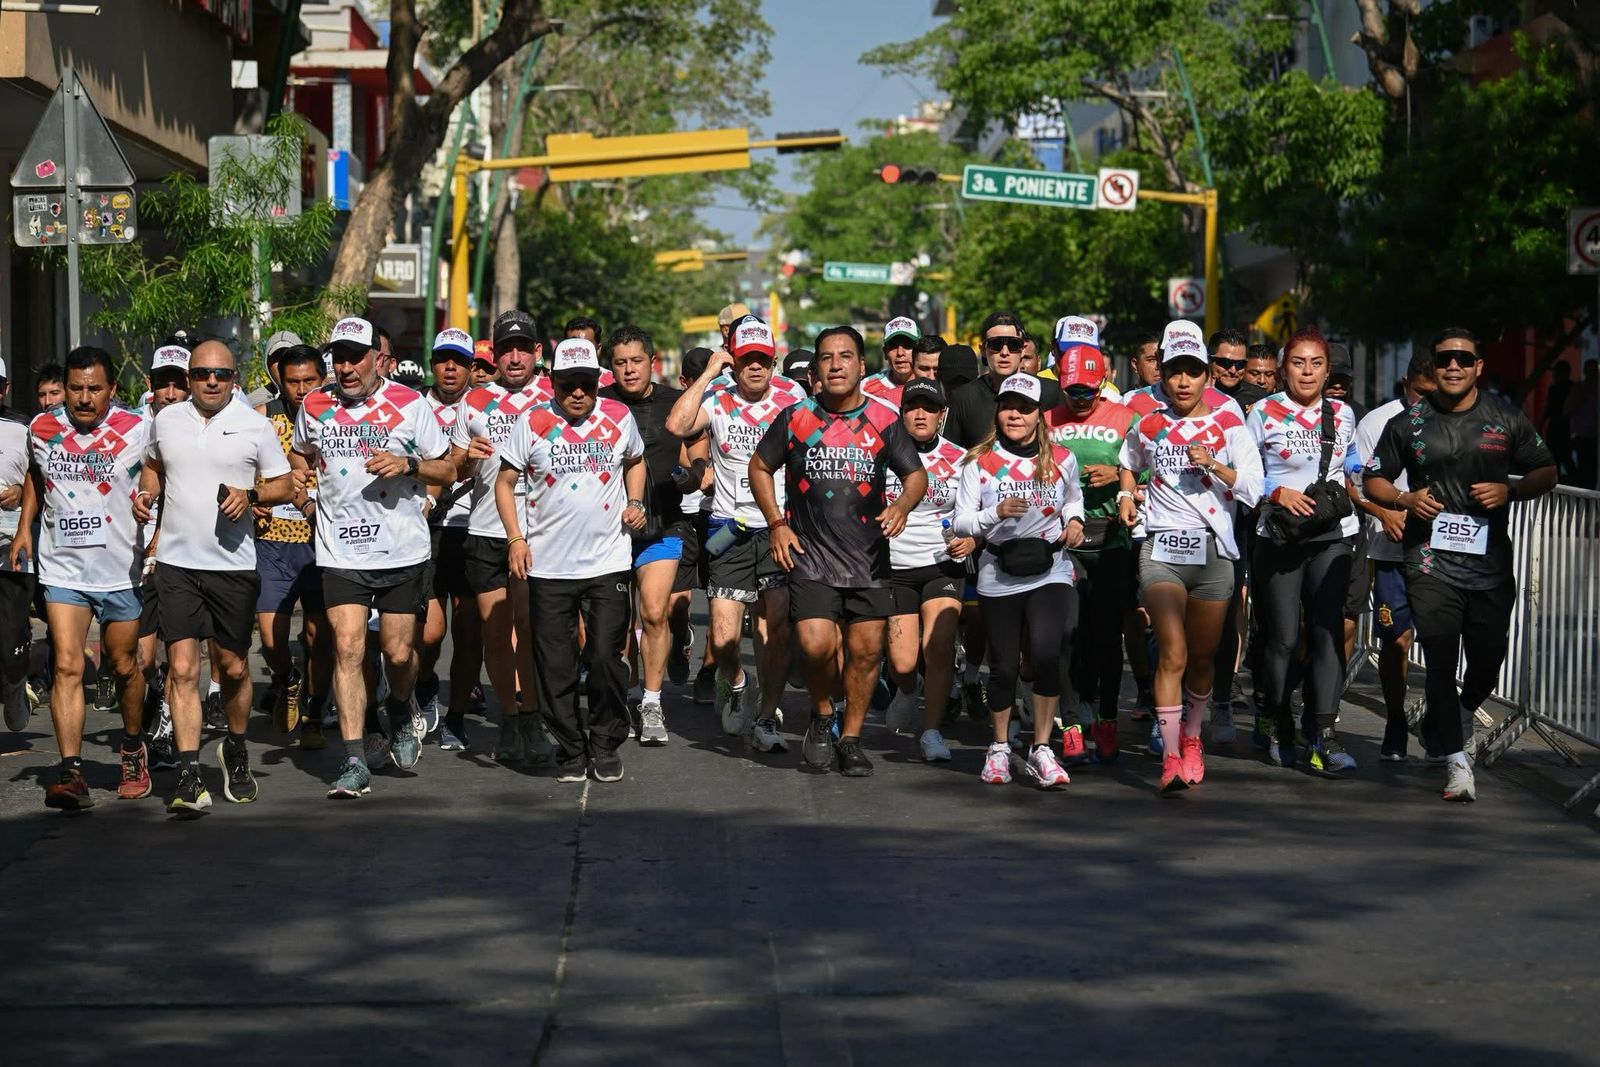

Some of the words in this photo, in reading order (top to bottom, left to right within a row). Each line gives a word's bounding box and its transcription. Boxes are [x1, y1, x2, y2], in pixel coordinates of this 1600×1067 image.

[972, 173, 998, 193] 3a.
[1004, 175, 1088, 202] PONIENTE
[1586, 225, 1600, 246] 4
[321, 424, 389, 438] CARRERA
[488, 426, 512, 436] POR
[321, 438, 344, 450] POR
[348, 438, 363, 448] LA
[366, 438, 390, 449] PAZ
[727, 434, 749, 444] POR
[1286, 440, 1308, 448] POR
[337, 450, 364, 458] NUEVA
[551, 442, 614, 456] CARRERA
[806, 446, 874, 462] CARRERA
[48, 450, 115, 464] CARRERA
[551, 456, 575, 466] POR
[578, 456, 592, 465] LA
[595, 454, 614, 464] PAZ
[1155, 458, 1177, 468] POR
[48, 462, 72, 473] POR
[74, 464, 92, 474] LA
[93, 464, 115, 475] PAZ
[568, 466, 596, 474] NUEVA
[805, 460, 832, 470] POR
[834, 460, 850, 472] LA
[854, 461, 876, 474] PAZ
[64, 474, 92, 482] NUEVA
[822, 471, 852, 480] NUEVA
[933, 490, 950, 498] PAZ
[1023, 492, 1036, 500] LA
[1040, 490, 1058, 500] PAZ
[60, 516, 102, 530] 0669
[1438, 520, 1482, 537] 2857
[339, 524, 381, 539] 2697
[1158, 534, 1201, 549] 4892
